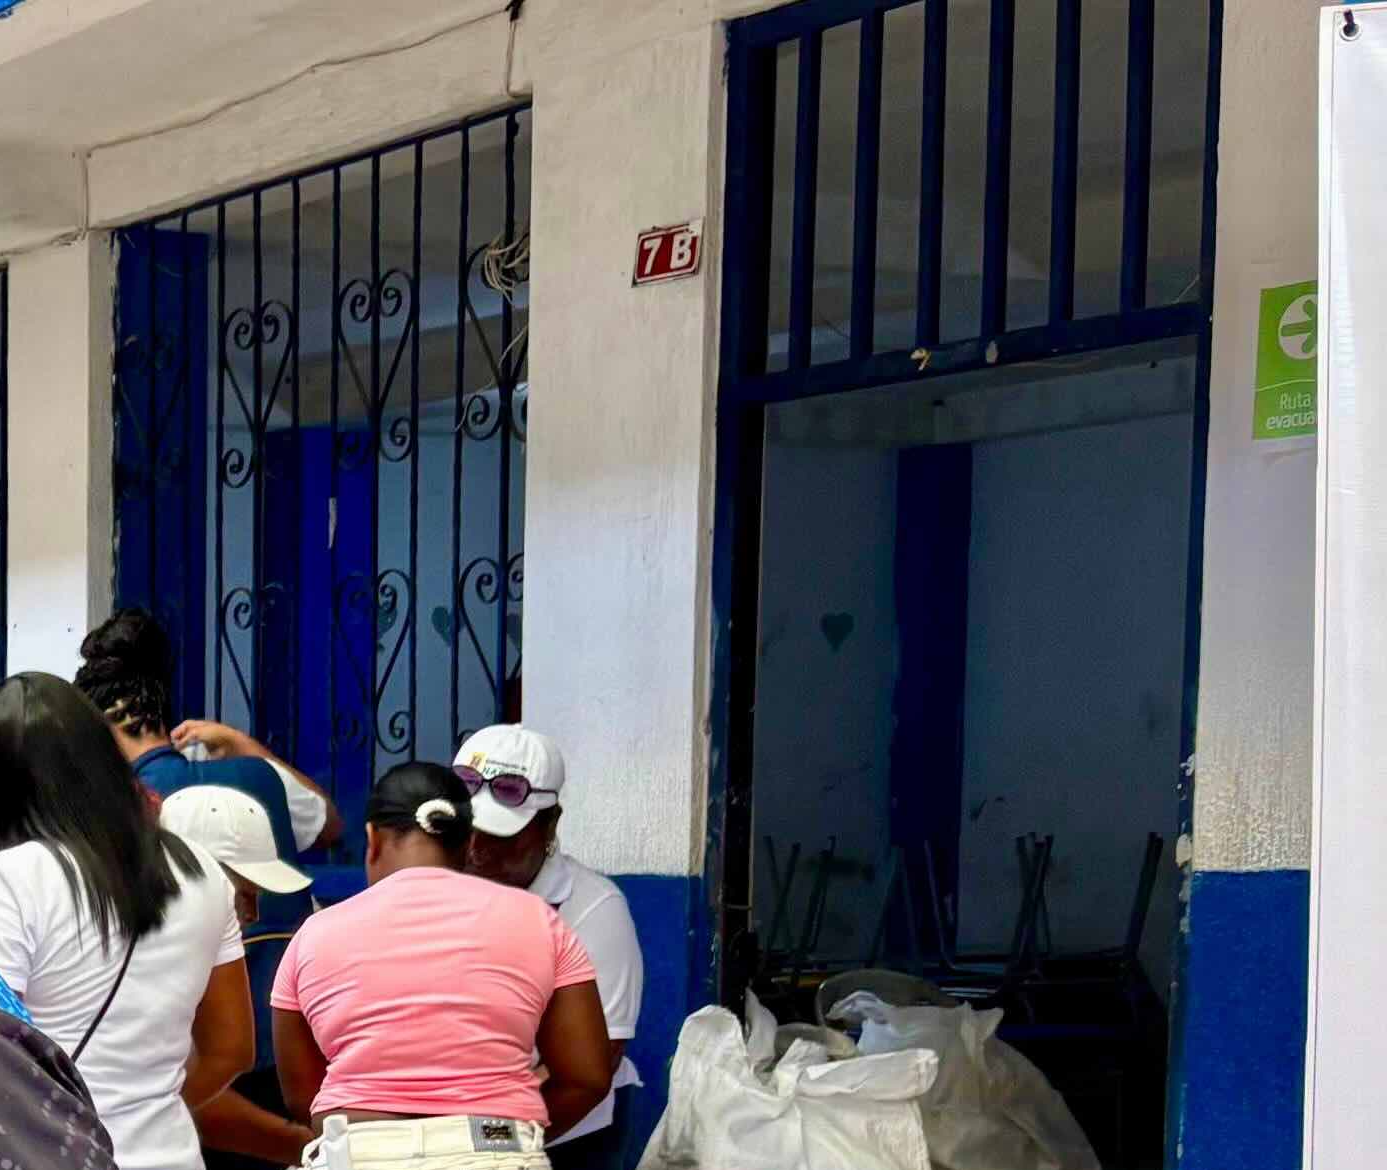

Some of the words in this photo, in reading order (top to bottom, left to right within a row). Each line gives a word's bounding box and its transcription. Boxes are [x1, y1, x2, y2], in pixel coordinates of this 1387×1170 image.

[643, 237, 663, 275] 7
[670, 231, 693, 270] B
[1279, 393, 1312, 409] Ruta
